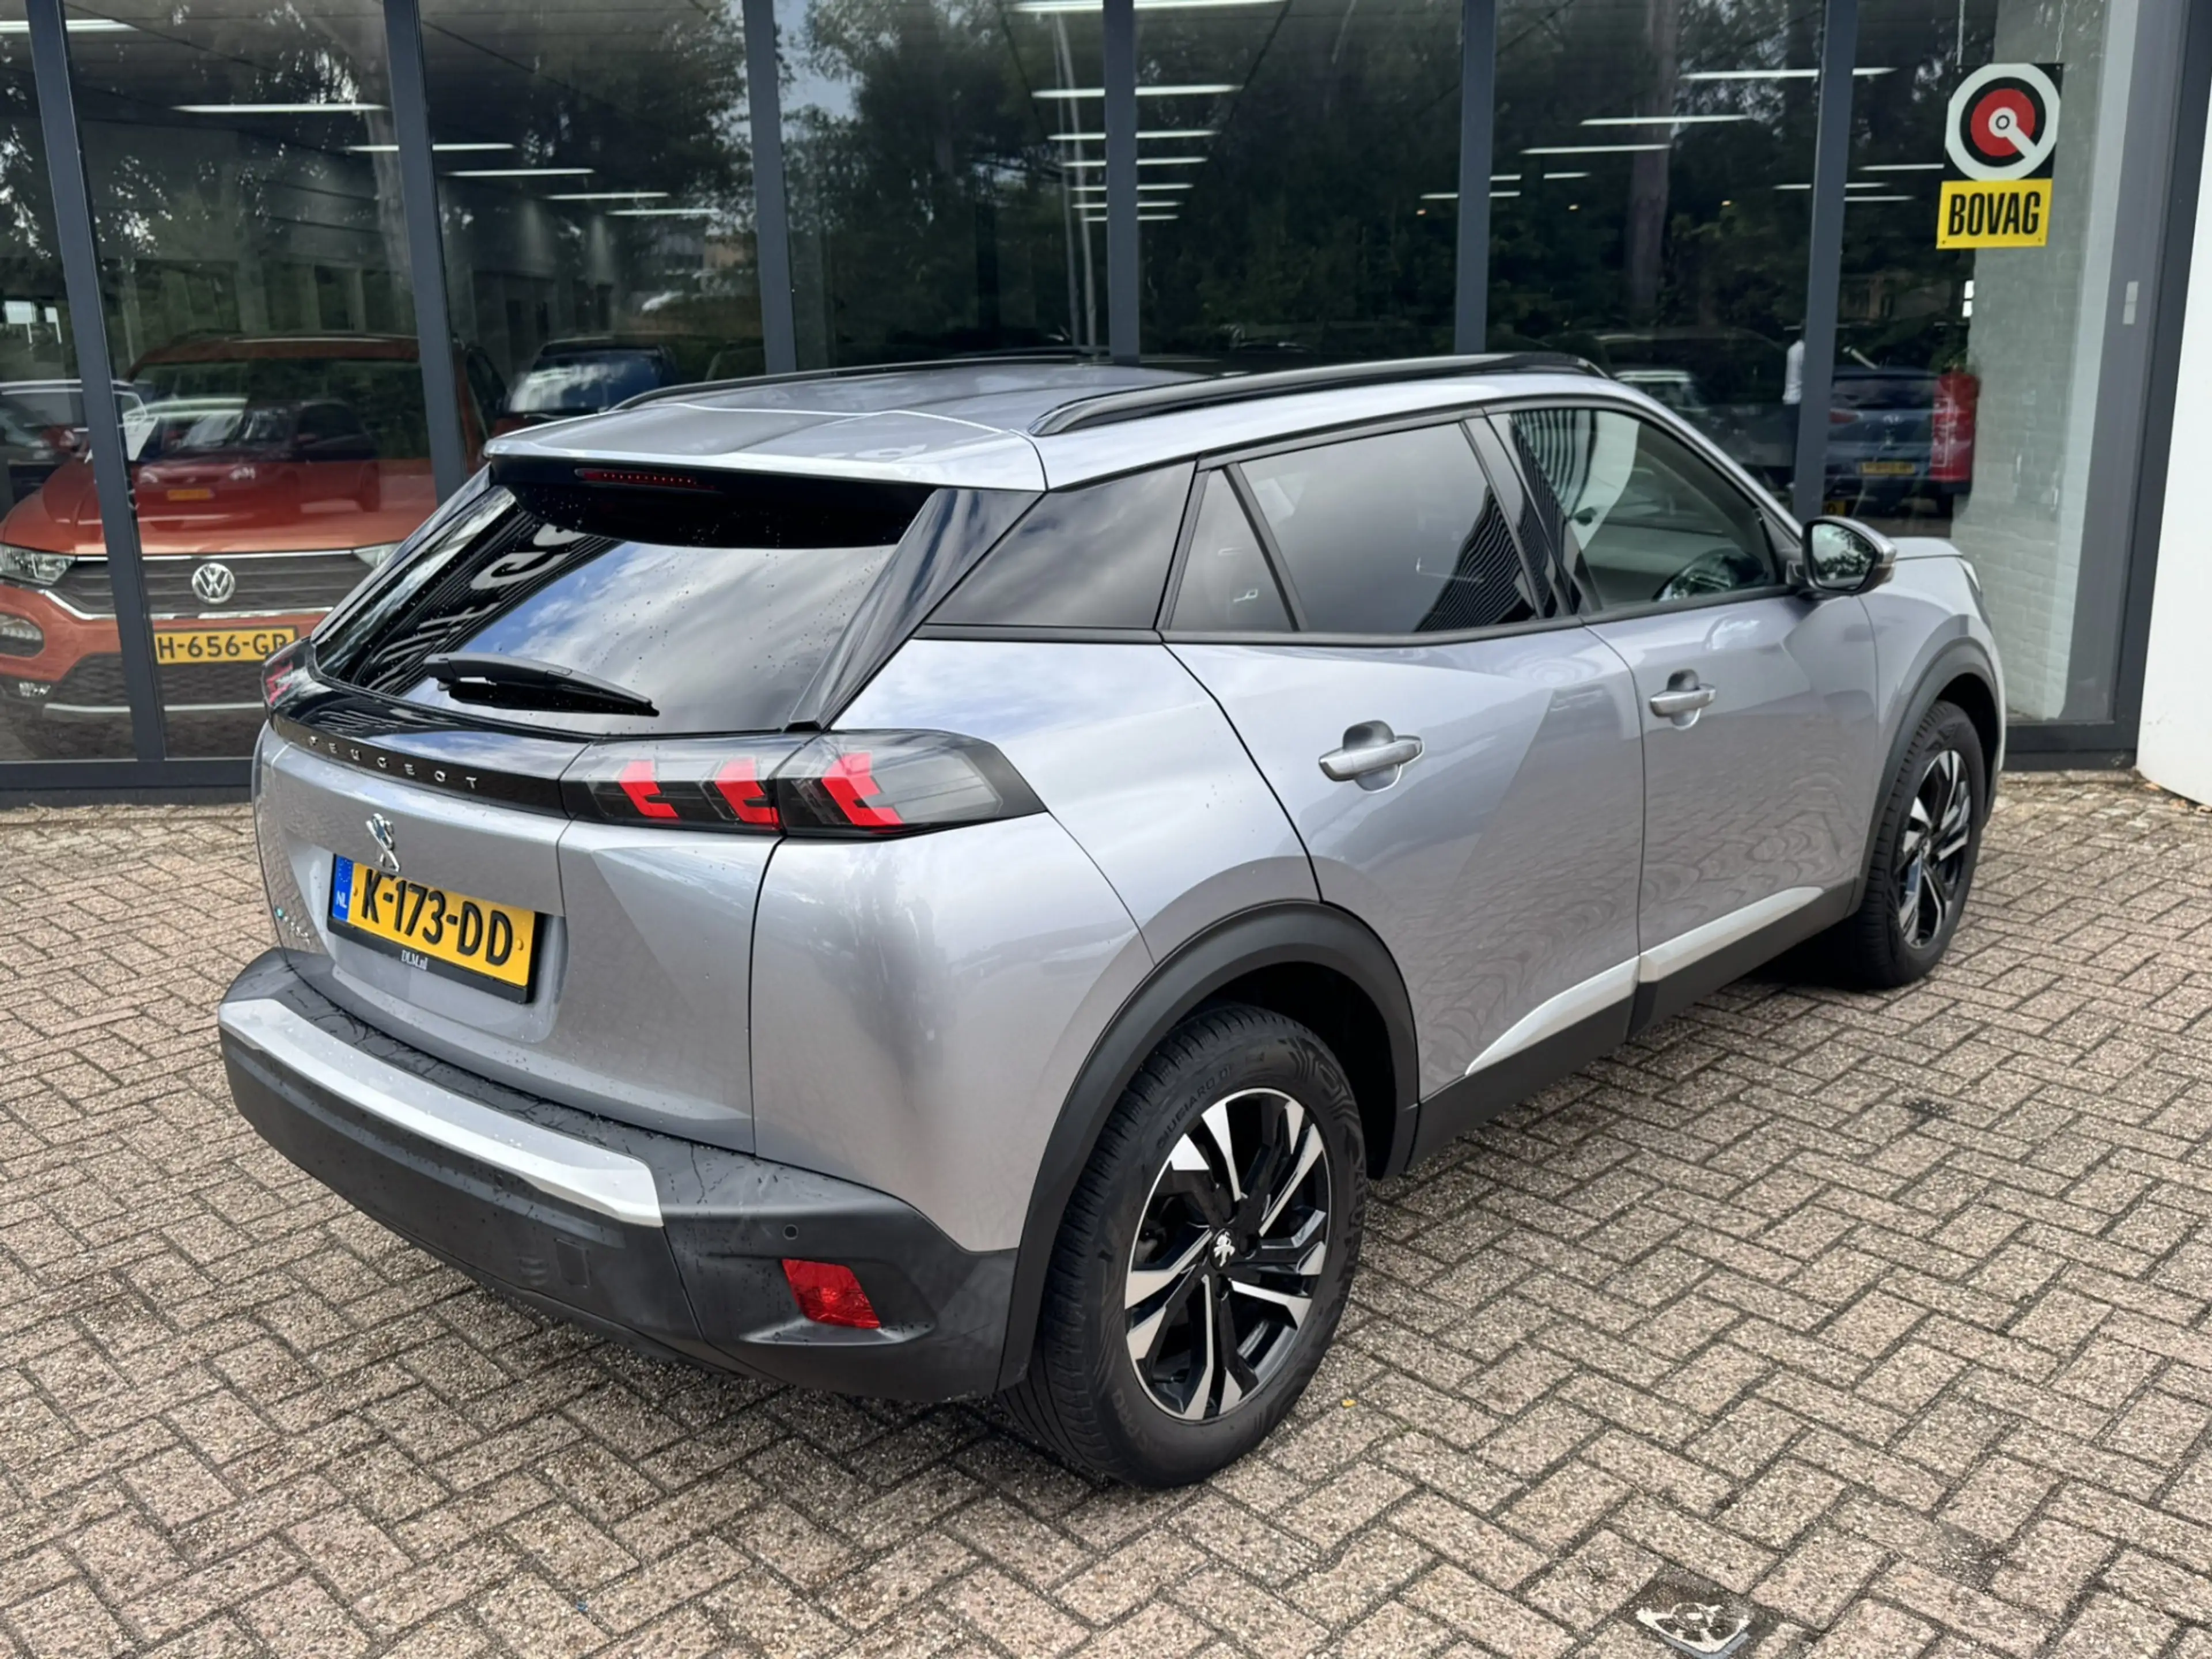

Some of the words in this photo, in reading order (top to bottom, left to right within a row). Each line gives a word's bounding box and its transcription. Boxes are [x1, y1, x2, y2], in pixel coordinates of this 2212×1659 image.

[1948, 191, 2041, 236] BOVAG
[309, 736, 477, 789] PEUGEOT
[336, 891, 347, 908] NL
[361, 869, 513, 966] K-173-DD
